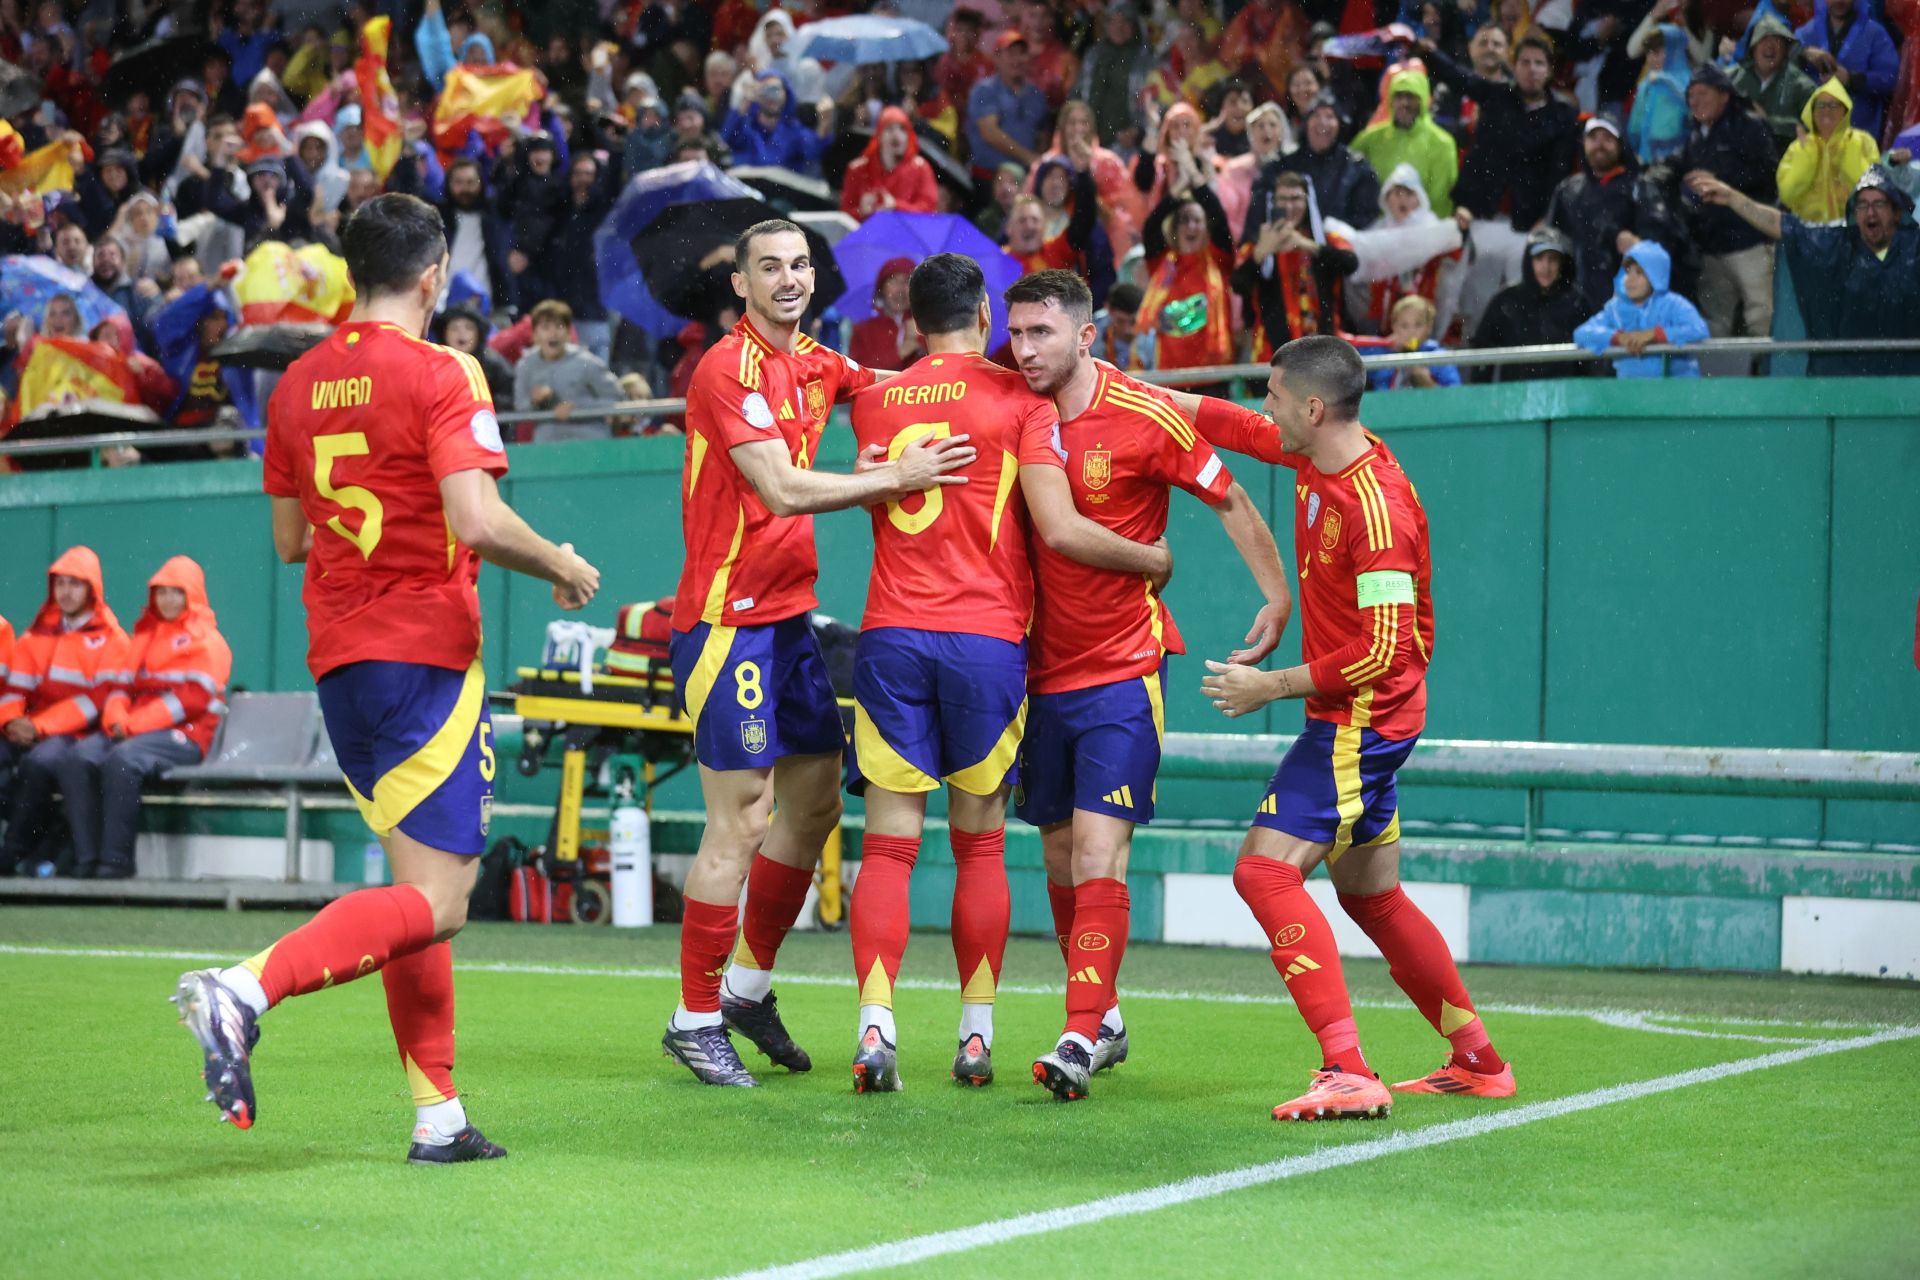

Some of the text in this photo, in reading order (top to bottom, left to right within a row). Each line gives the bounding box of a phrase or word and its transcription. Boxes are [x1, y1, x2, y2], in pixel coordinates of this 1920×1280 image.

[311, 376, 372, 410] VIVIAN
[883, 380, 967, 408] MERINO
[313, 431, 384, 562] 5
[734, 660, 764, 710] 8
[479, 721, 496, 782] 5
